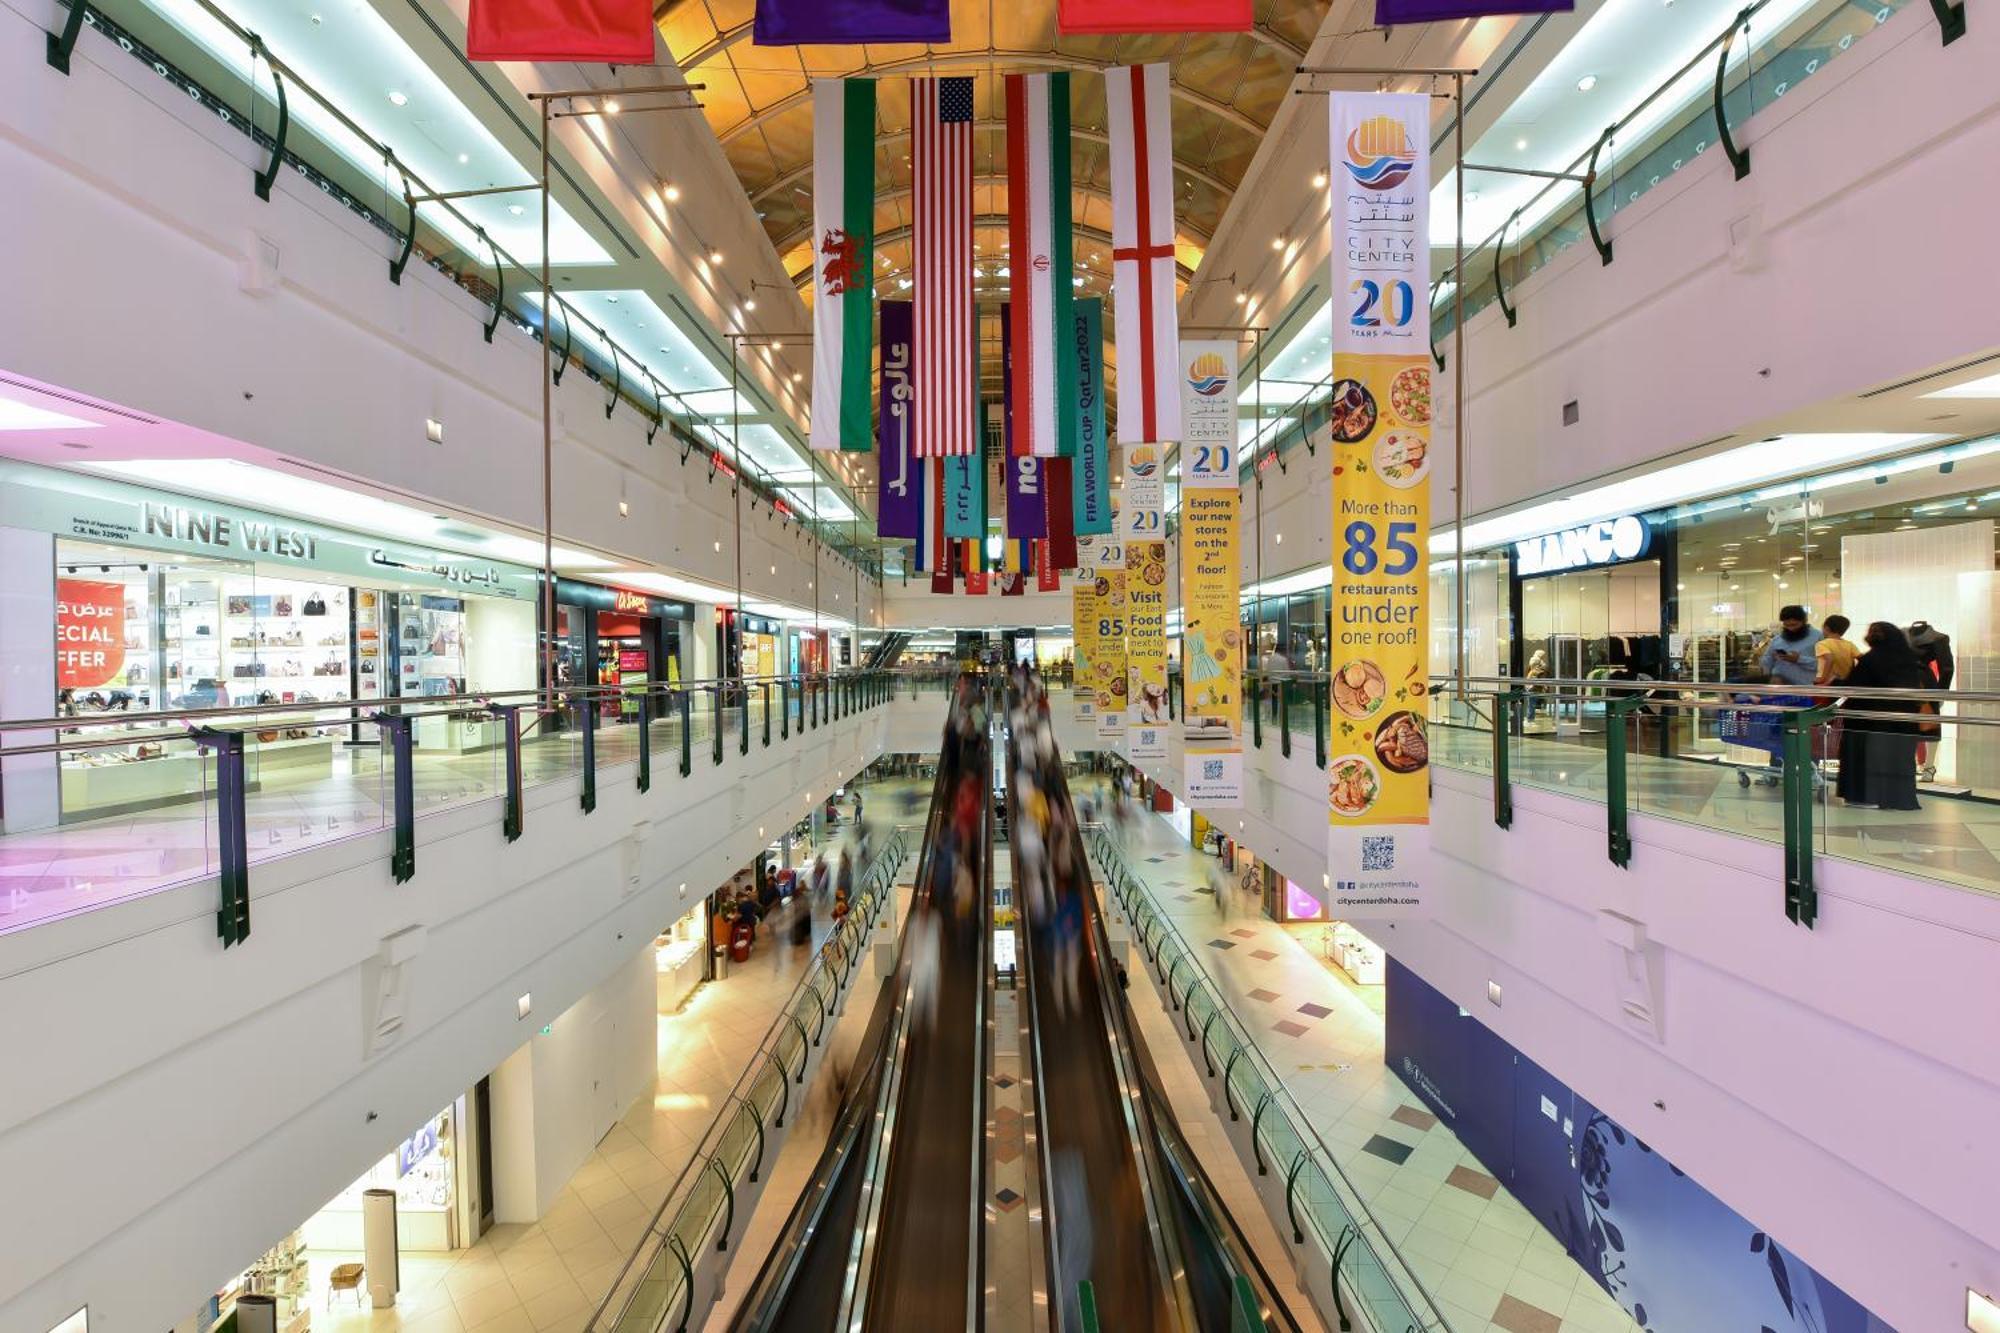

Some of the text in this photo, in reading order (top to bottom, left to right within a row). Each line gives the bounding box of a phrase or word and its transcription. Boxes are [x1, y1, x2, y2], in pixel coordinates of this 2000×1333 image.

[1348, 236, 1414, 249] CITY
[1348, 250, 1415, 263] CENTER
[1350, 278, 1414, 327] 20
[1351, 329, 1378, 338] YEARS
[1082, 418, 1094, 442] CUP
[1192, 445, 1229, 473] 20
[1018, 456, 1038, 494] no
[1083, 443, 1096, 493] WORLD
[1085, 493, 1097, 522] FIFA
[1190, 498, 1231, 509] Explore
[1341, 499, 1418, 516] More than
[1132, 511, 1158, 530] 20
[1189, 513, 1232, 521] our new
[143, 502, 318, 560] NINE WEST
[1195, 526, 1227, 535] stores
[1194, 538, 1229, 548] on the
[1342, 521, 1419, 576] 85
[1516, 516, 1644, 576] MANGO
[1101, 545, 1121, 562] 20
[1204, 551, 1220, 561] 2nd
[1197, 564, 1227, 575] floor!
[1130, 591, 1162, 603] Visit
[1341, 584, 1418, 596] restaurants
[72, 602, 114, 618] عرض
[1343, 598, 1419, 624] under
[1099, 619, 1124, 636] 85
[1131, 614, 1162, 625] Food
[57, 625, 114, 643] ECIAL
[1131, 627, 1162, 637] Court
[1341, 627, 1418, 645] one roof!
[1154, 639, 1164, 647] to
[57, 650, 106, 668] FFER
[1131, 649, 1146, 657] Fun
[1147, 649, 1164, 657] City
[1337, 896, 1420, 906] citycenterdoha.com
